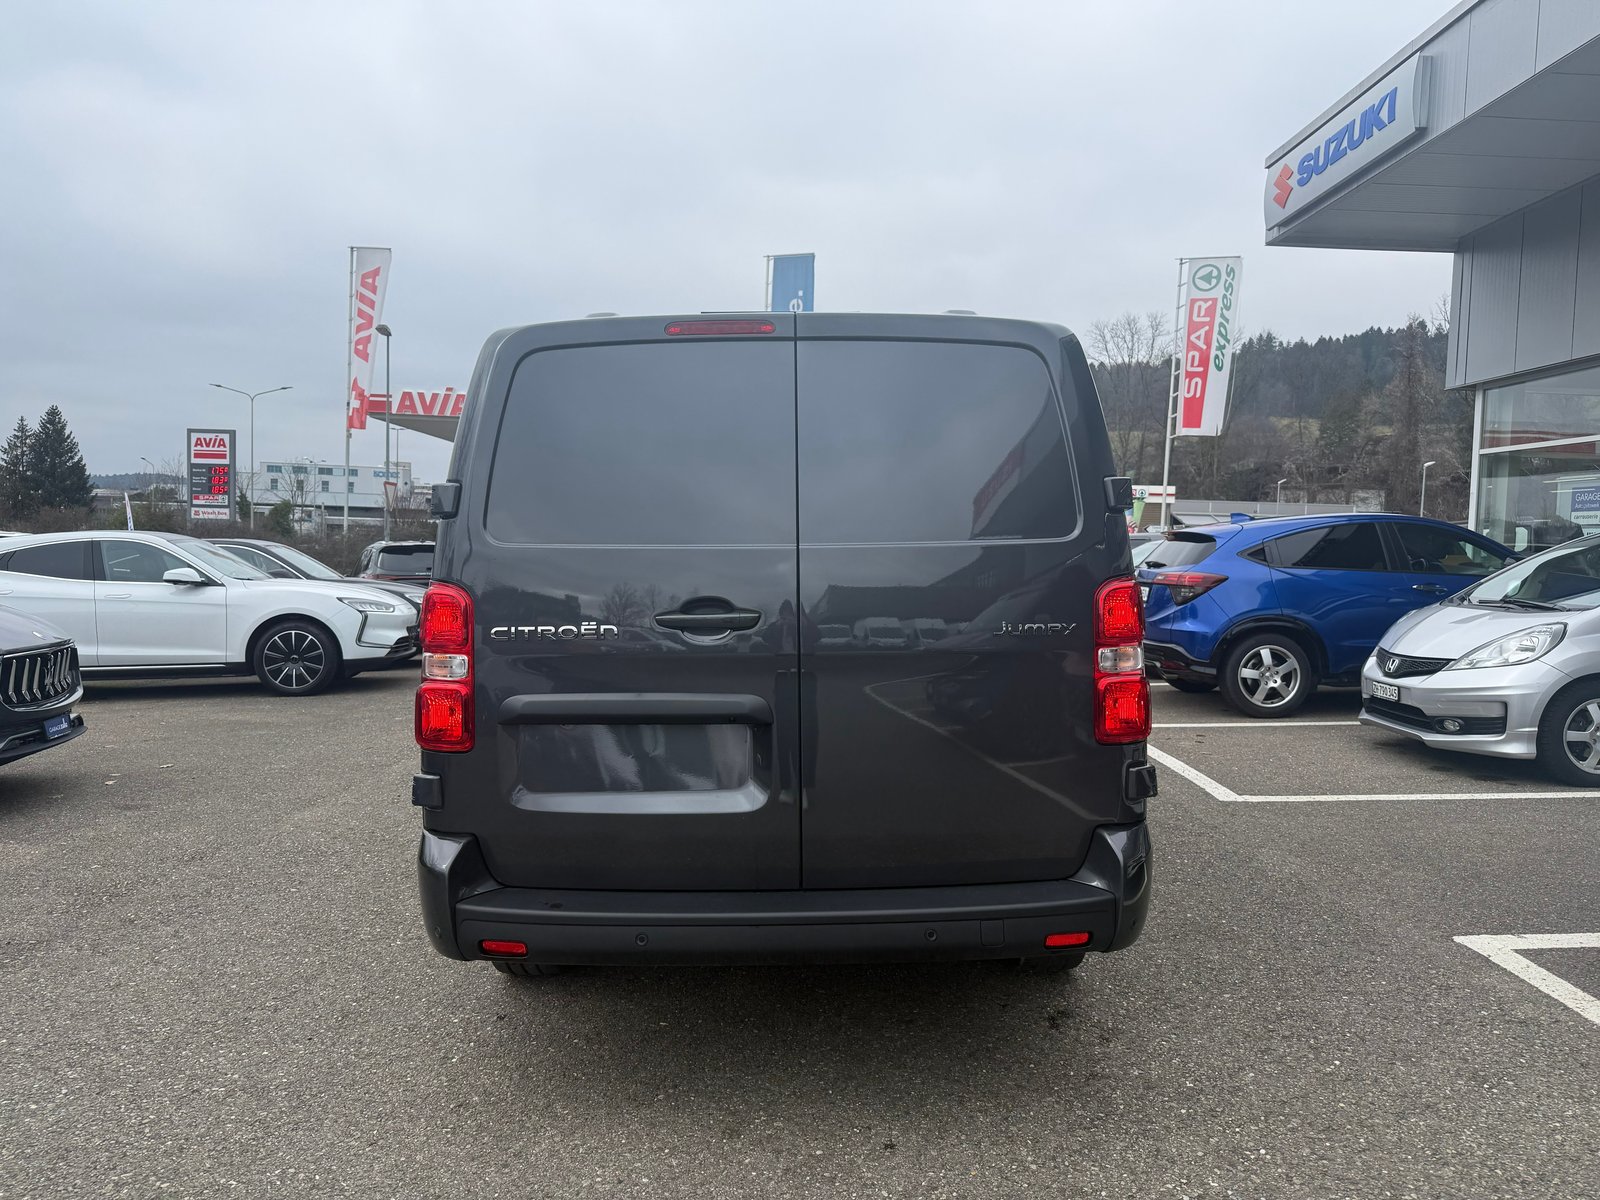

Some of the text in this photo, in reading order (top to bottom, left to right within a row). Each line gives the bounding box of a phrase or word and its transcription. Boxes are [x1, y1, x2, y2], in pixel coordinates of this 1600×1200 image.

[1297, 87, 1398, 187] SUZUKI
[354, 266, 381, 363] AVIA
[1184, 300, 1212, 398] SPAR
[1214, 264, 1235, 372] express
[194, 435, 227, 449] AVIA
[490, 621, 618, 640] CITROËN
